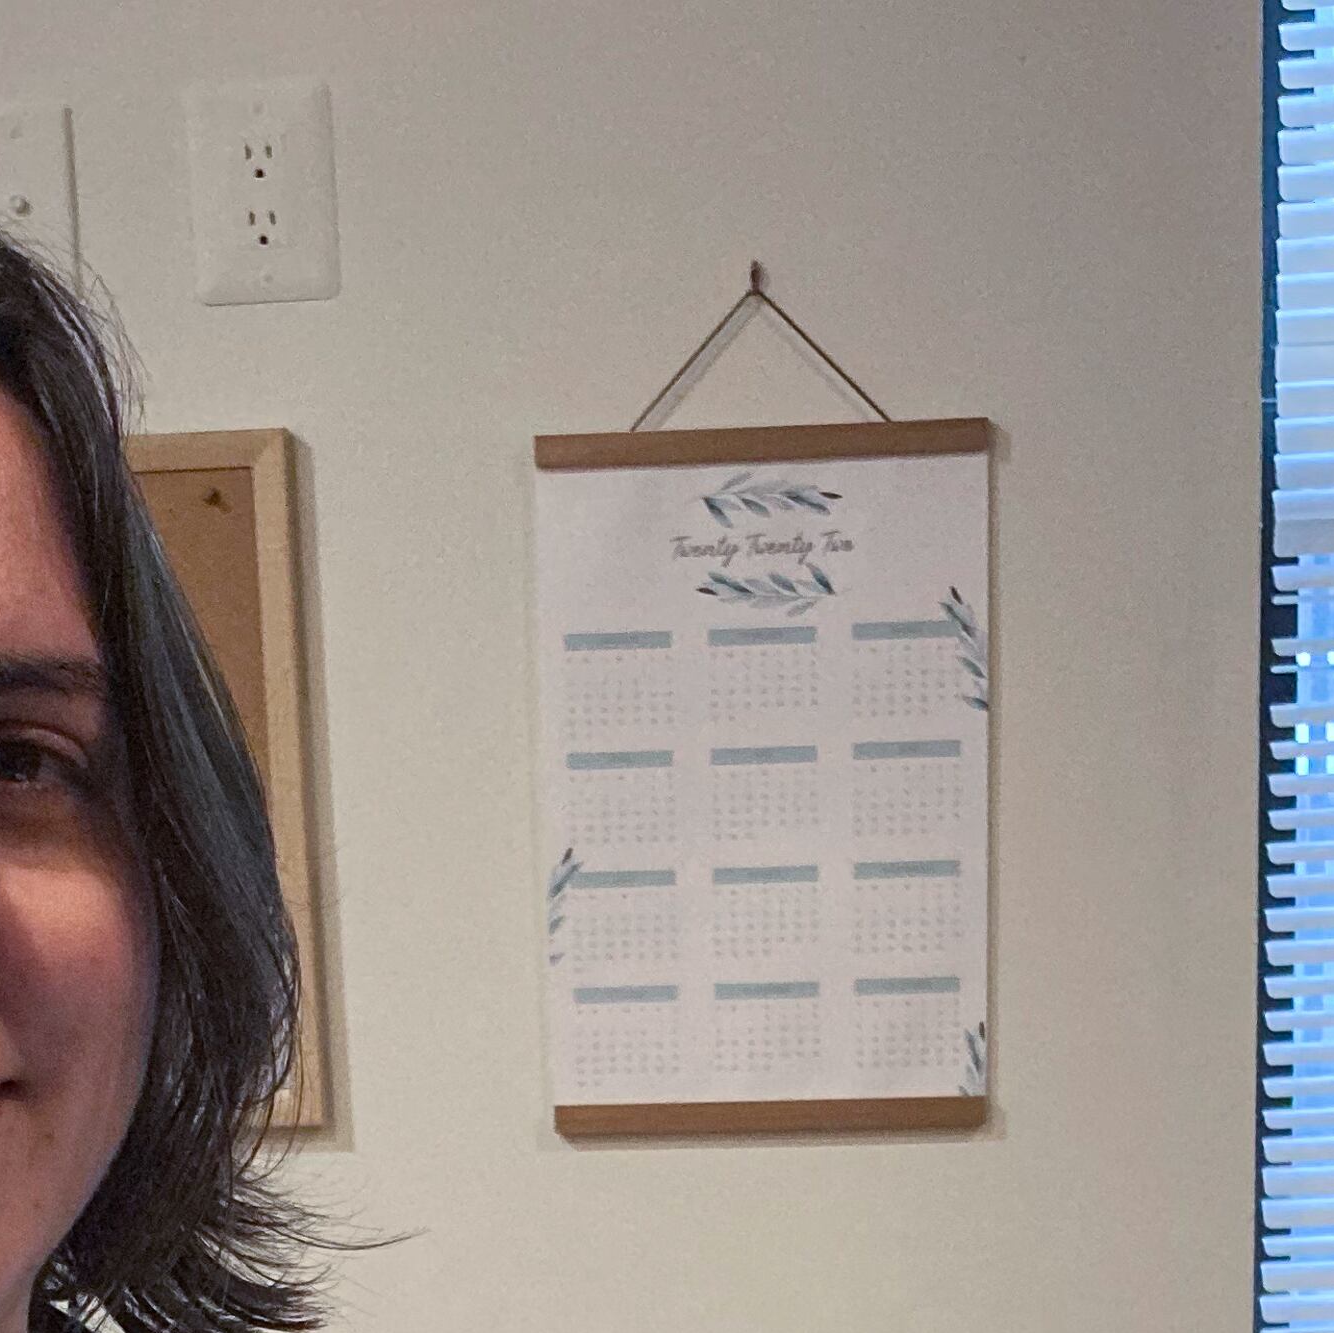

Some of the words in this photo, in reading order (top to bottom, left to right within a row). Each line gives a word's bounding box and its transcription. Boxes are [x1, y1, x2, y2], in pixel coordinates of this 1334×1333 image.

[670, 535, 739, 568] Twenty
[745, 531, 815, 566] Twenty
[820, 529, 855, 557] Two
